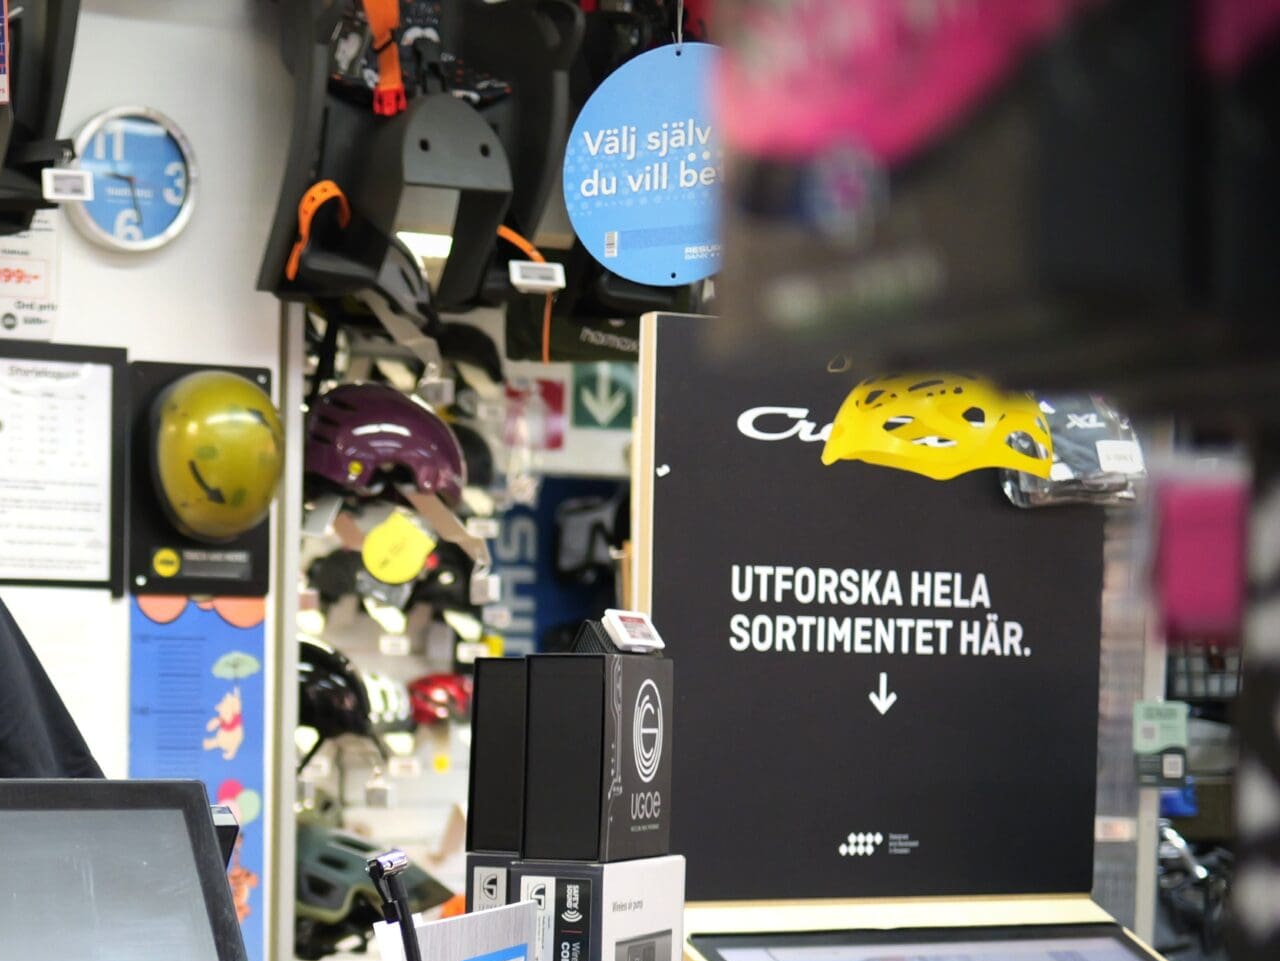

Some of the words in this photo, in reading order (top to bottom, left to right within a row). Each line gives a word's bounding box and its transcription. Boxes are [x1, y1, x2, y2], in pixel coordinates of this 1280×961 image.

[584, 126, 636, 160] Välj
[647, 119, 712, 157] själv
[581, 169, 617, 197] du
[628, 162, 668, 193] vill
[1066, 413, 1106, 429] XL
[731, 564, 903, 606] UTFORSKA
[910, 570, 991, 609] HELA
[729, 613, 952, 655] SORTIMENTET
[959, 613, 1031, 656] HÄR.
